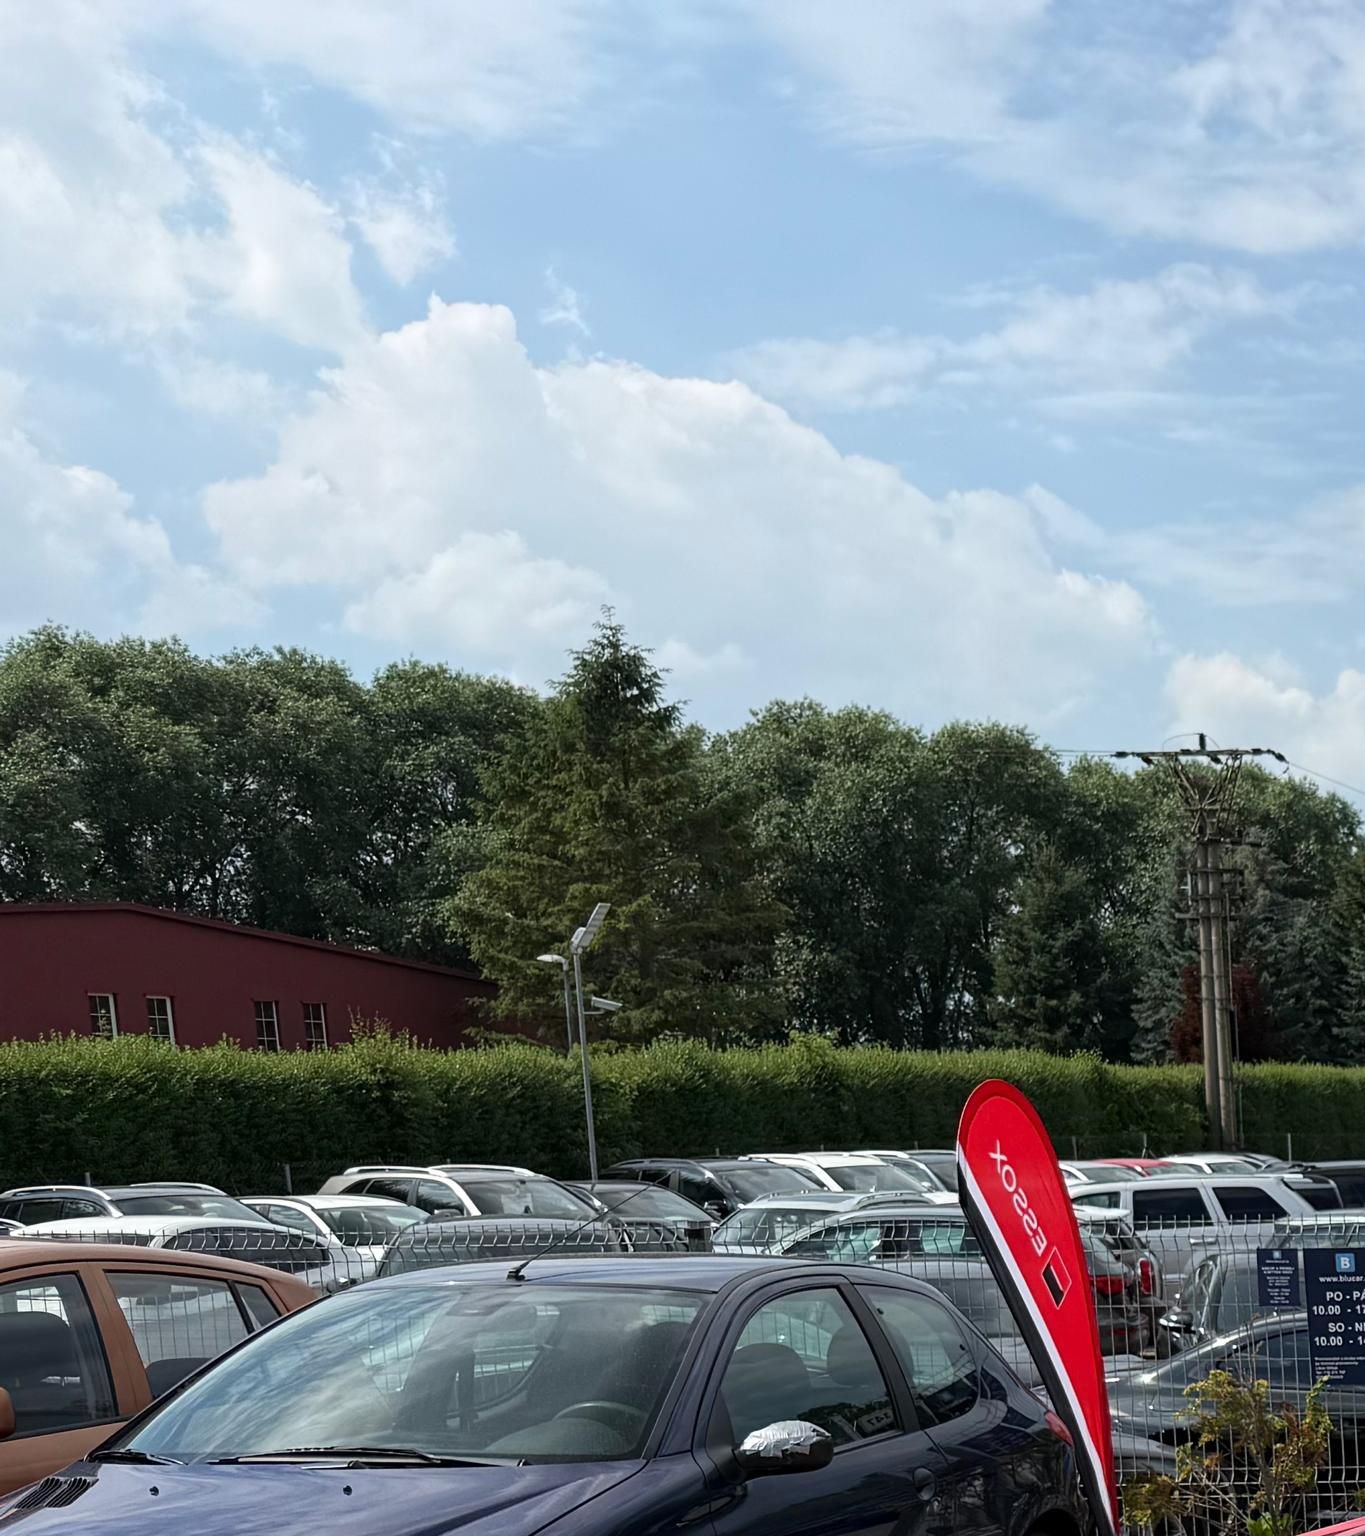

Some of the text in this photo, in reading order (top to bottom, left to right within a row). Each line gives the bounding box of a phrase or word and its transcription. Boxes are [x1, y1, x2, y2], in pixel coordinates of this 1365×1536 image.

[1340, 1256, 1351, 1269] B
[1326, 1291, 1343, 1301] PO
[1312, 1305, 1341, 1315] 10.00
[1328, 1322, 1345, 1332] SO
[1314, 1336, 1343, 1346] 10.00
